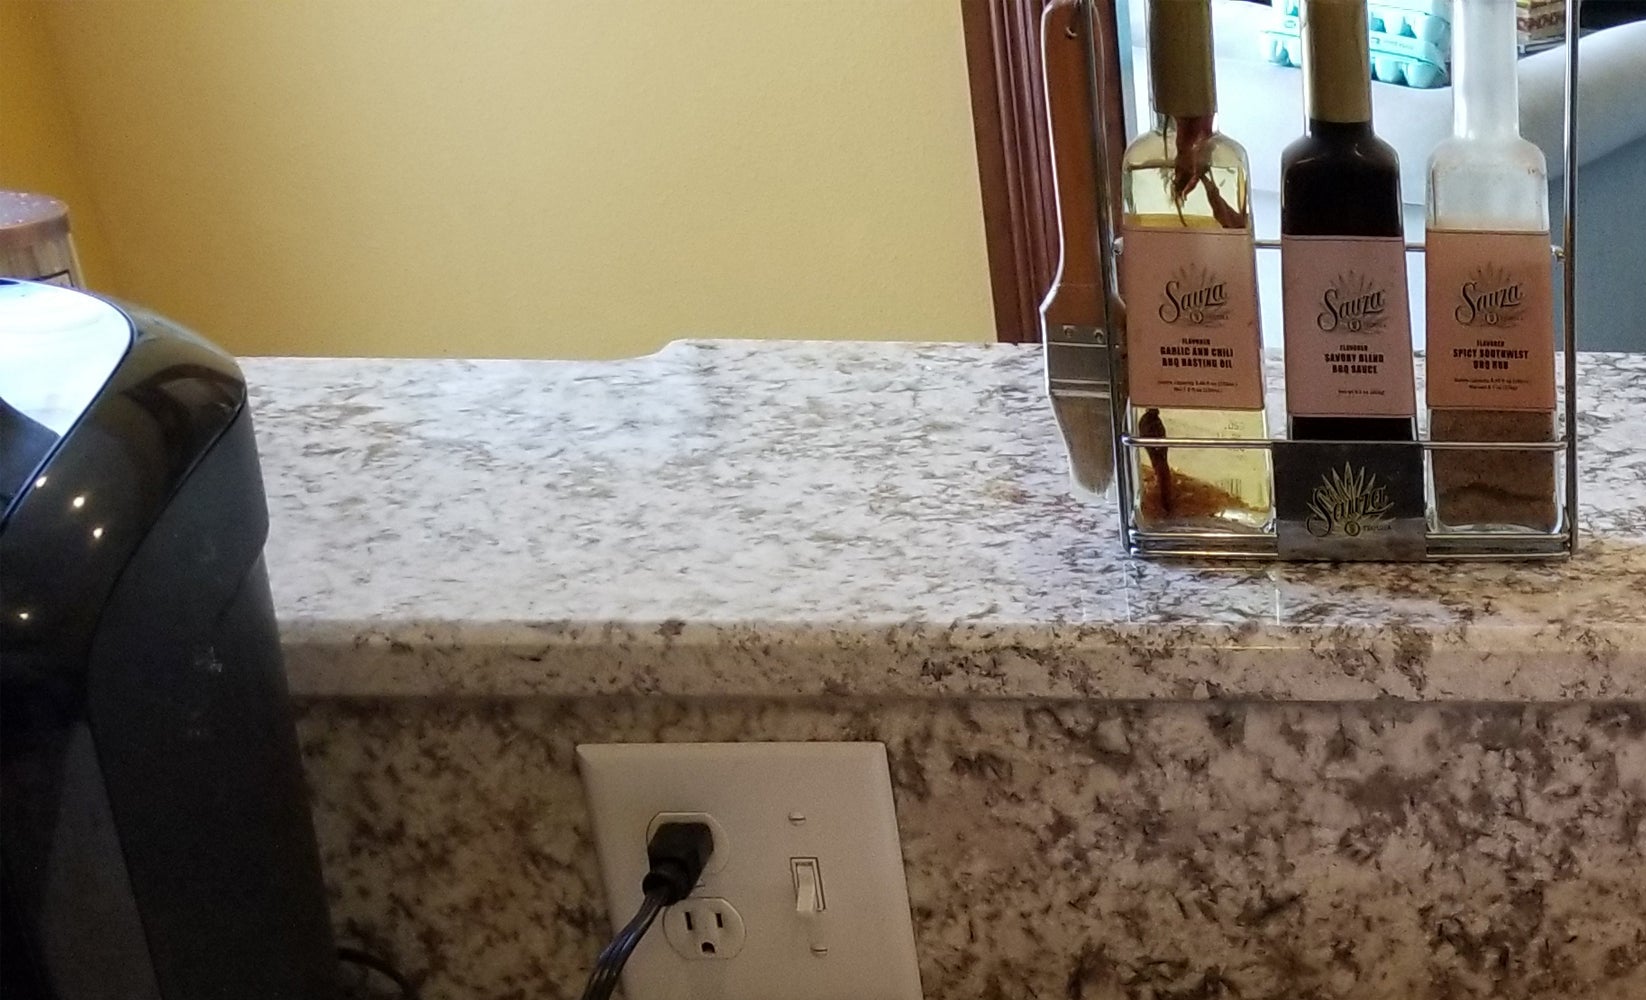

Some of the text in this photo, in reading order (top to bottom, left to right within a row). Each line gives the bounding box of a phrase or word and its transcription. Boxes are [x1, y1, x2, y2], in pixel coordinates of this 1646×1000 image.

[1159, 280, 1227, 324] Sauza
[1455, 281, 1523, 326] Sauza
[1317, 288, 1385, 332] Sauza
[1160, 346, 1234, 357] GARLIC AND CHILI
[1453, 348, 1529, 359] SPICY SOUTHWEST
[1162, 358, 1233, 369] BBQ BASTING OIL
[1324, 353, 1385, 363] SAVORY BLEND
[1332, 364, 1378, 374] BBQ SAUCE
[1473, 360, 1509, 370] BBQ RUB
[1306, 486, 1392, 537] Sauza
